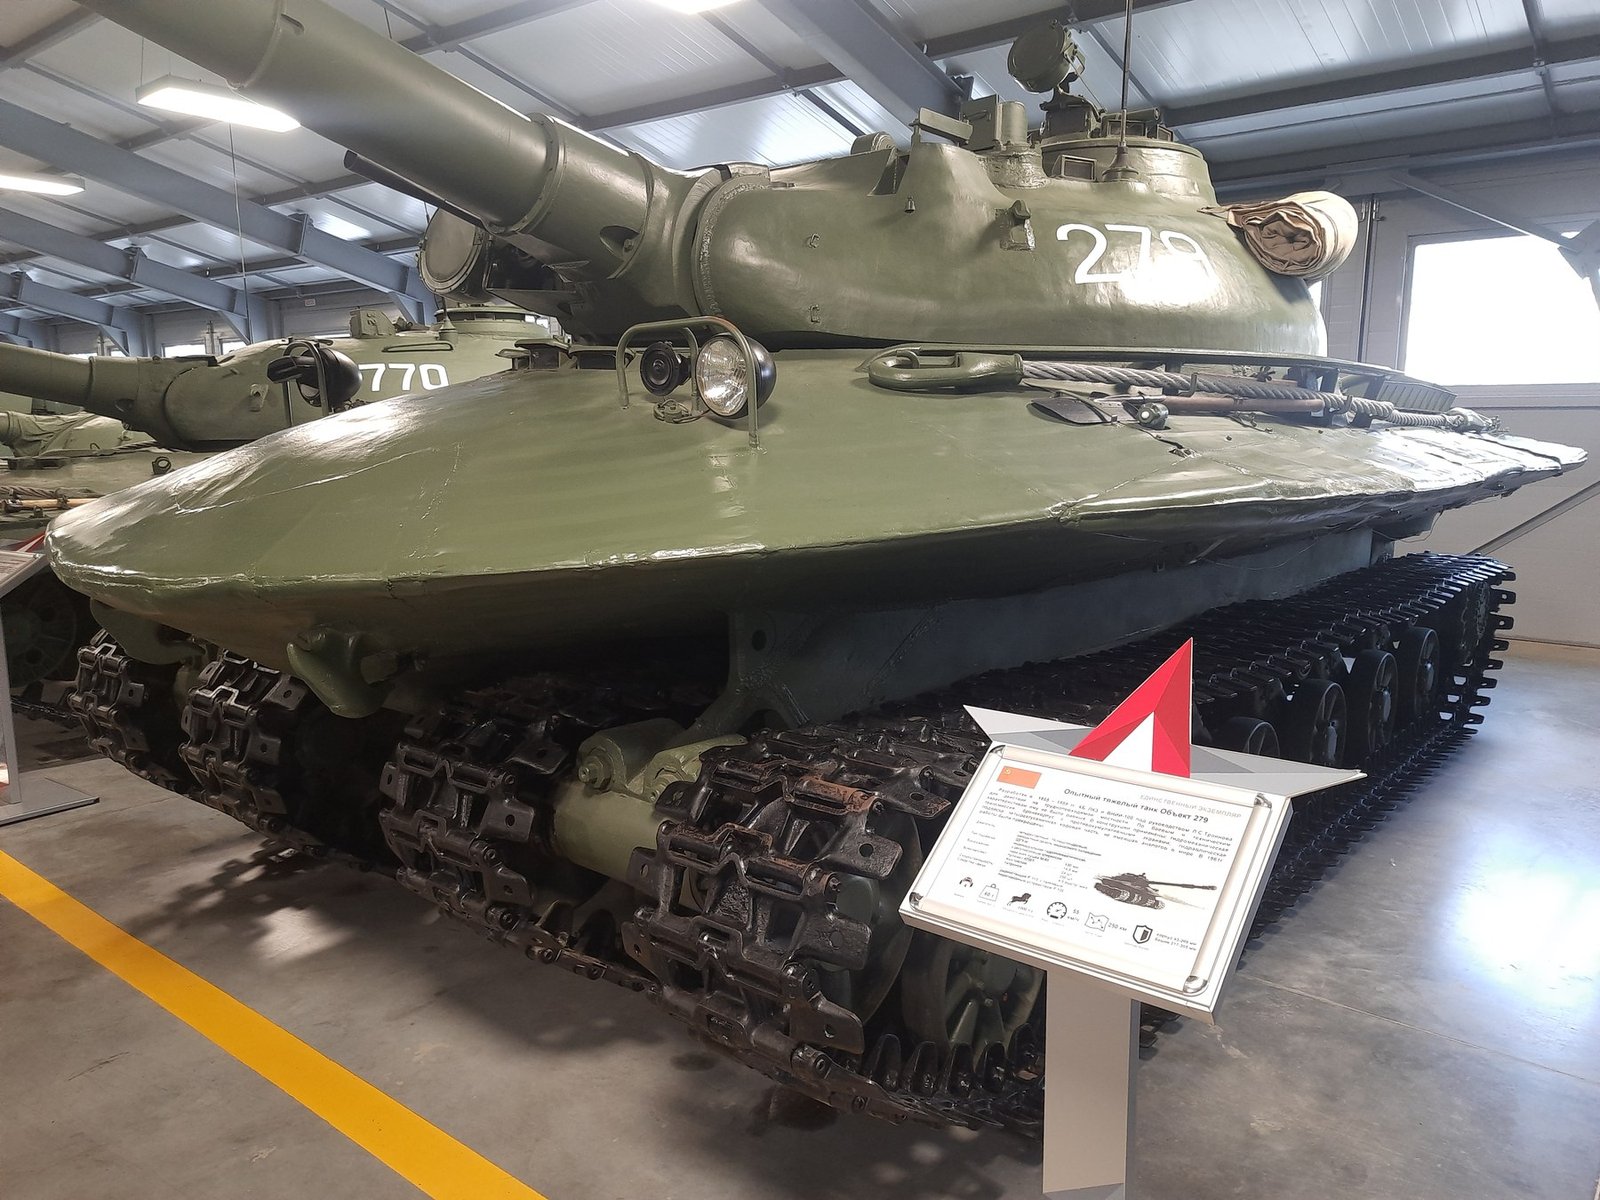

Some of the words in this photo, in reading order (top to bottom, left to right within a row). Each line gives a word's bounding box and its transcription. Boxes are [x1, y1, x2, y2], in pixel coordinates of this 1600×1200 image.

[1056, 223, 1219, 292] 279
[358, 363, 450, 392] 770
[1064, 788, 1101, 800] Опытный
[1103, 797, 1138, 808] тяжелый
[1141, 805, 1158, 813] танк
[1160, 808, 1191, 819] Объект
[1193, 815, 1209, 823] 279
